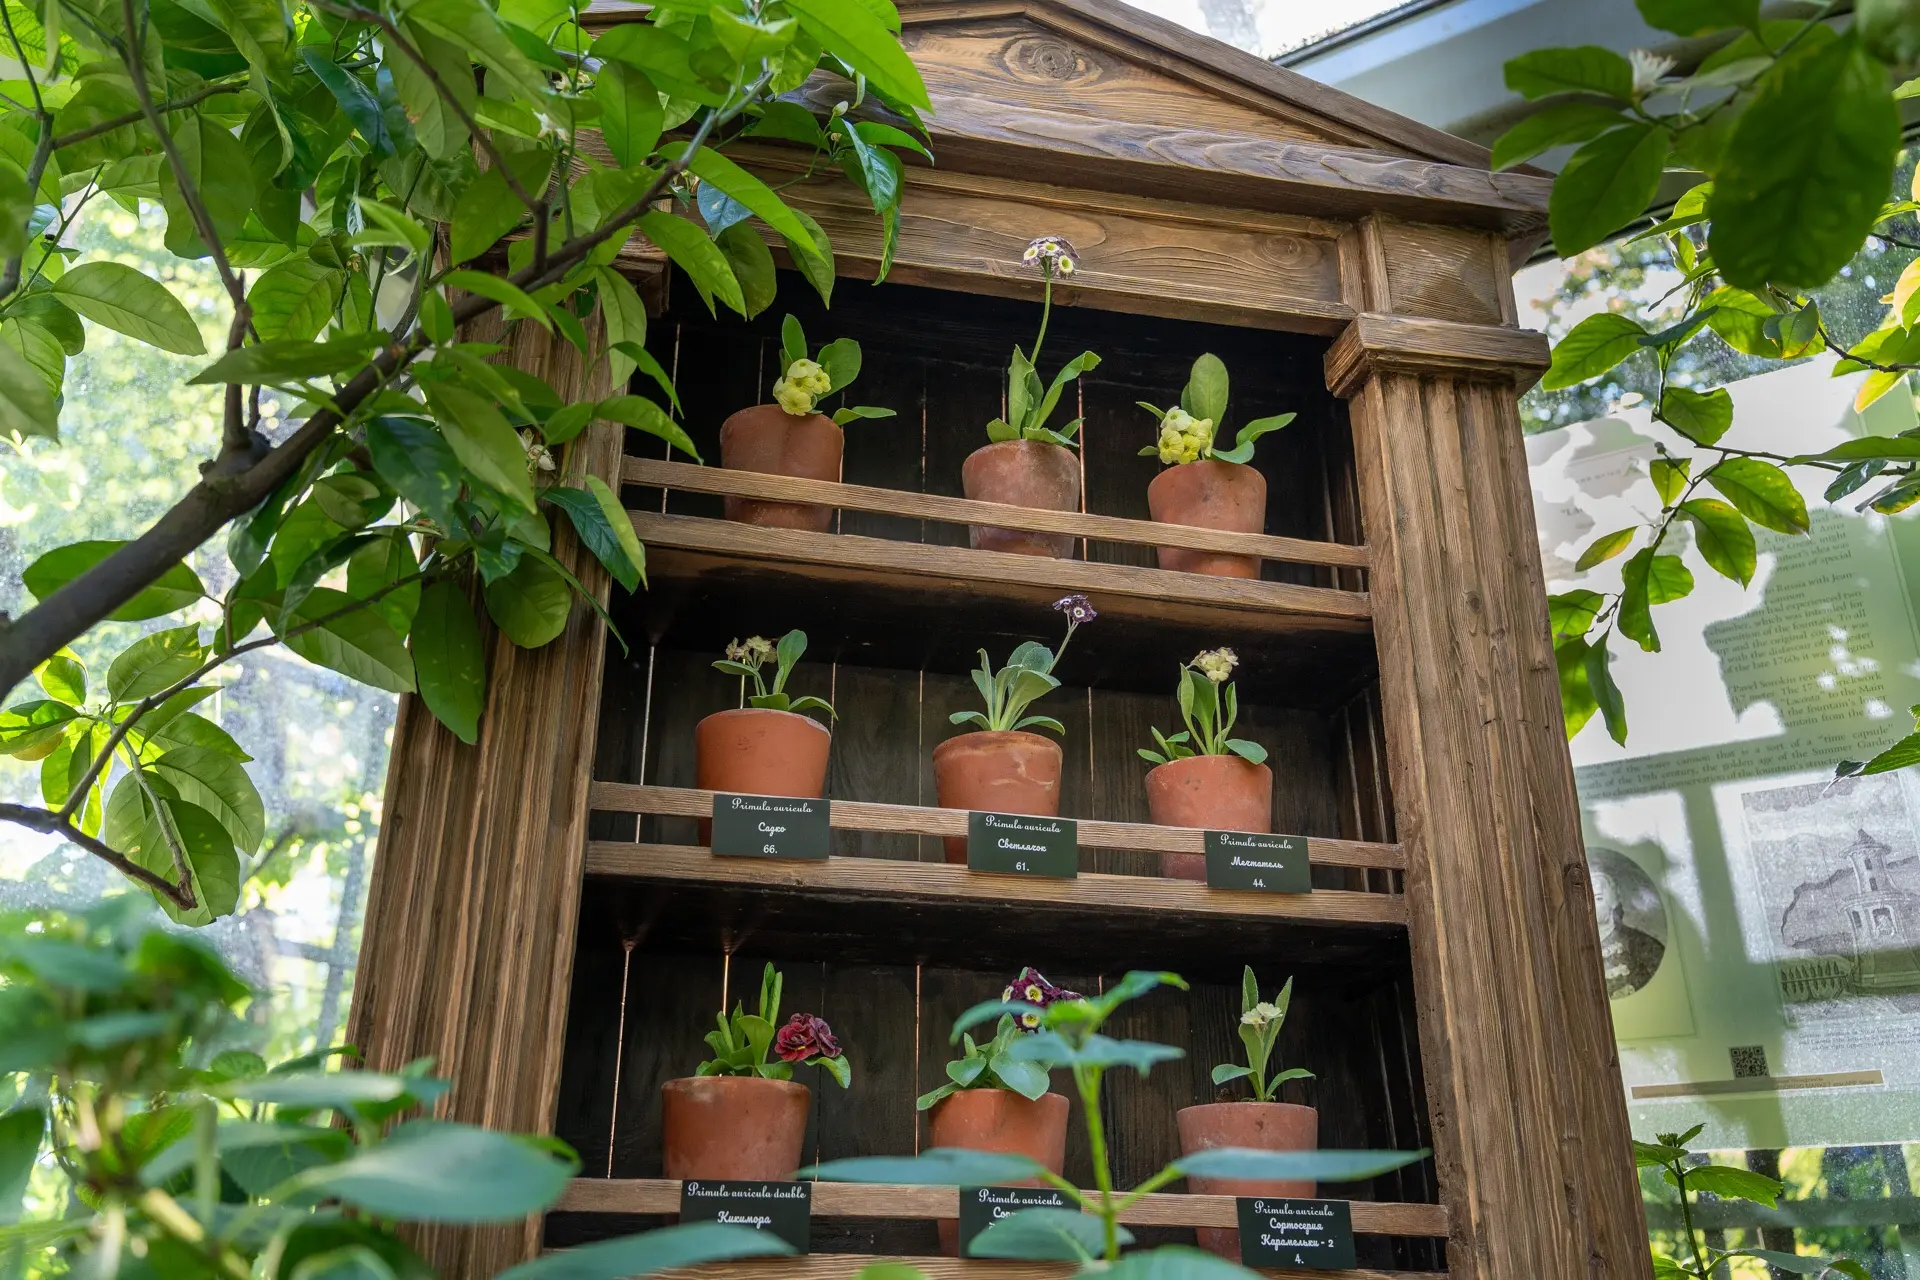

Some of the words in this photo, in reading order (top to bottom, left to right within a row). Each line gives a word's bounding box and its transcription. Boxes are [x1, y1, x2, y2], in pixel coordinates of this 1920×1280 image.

[1808, 558, 1818, 566] of
[1820, 549, 1853, 565] special
[1776, 582, 1807, 593] Russia
[1808, 574, 1830, 586] with
[1766, 602, 1783, 614] had
[1786, 591, 1842, 611] experienced
[1843, 590, 1863, 600] two
[1785, 612, 1803, 621] was
[1849, 599, 1864, 610] for
[1710, 630, 1760, 646] omposition
[1763, 627, 1772, 636] of
[1775, 624, 1790, 634] the
[1839, 612, 1853, 621] To
[1854, 607, 1867, 619] all
[1732, 641, 1749, 653] and
[1752, 638, 1768, 649] the
[1770, 630, 1808, 647] original
[1851, 621, 1869, 630] was
[1727, 651, 1748, 664] with
[1751, 649, 1766, 659] the
[1814, 639, 1824, 648] of
[1735, 662, 1751, 672] the
[1752, 660, 1770, 670] late
[1802, 652, 1810, 661] it
[1812, 650, 1830, 659] was
[1732, 681, 1758, 694] Pavel
[1759, 676, 1796, 688] Sorokin
[1780, 685, 1800, 696] The
[1827, 691, 1839, 699] to
[1840, 686, 1857, 697] the
[1859, 683, 1885, 694] Main
[1787, 706, 1804, 717] the
[1807, 698, 1857, 714] fountain's
[1779, 717, 1818, 729] ountain
[1821, 711, 1846, 723] from
[1848, 708, 1864, 719] the
[1715, 748, 1735, 760] that
[1766, 742, 1785, 752] sort
[1790, 737, 1801, 748] of
[1662, 768, 1699, 780] century,
[1702, 762, 1718, 772] the
[1721, 757, 1754, 771] golden
[1758, 755, 1773, 766] age
[1777, 752, 1788, 761] of
[1791, 748, 1808, 759] the
[1811, 743, 1853, 756] Summer
[731, 797, 772, 811] Primula
[773, 802, 813, 813] auricula
[985, 814, 1023, 830] Primula
[1024, 822, 1061, 833] auricula
[763, 844, 778, 854] 66.
[997, 838, 1047, 852] Светлячок
[1220, 833, 1257, 848] Primula
[1257, 839, 1293, 850] auricula
[1015, 861, 1030, 872] 61.
[1230, 856, 1284, 869] Мечтатель
[1253, 878, 1266, 888] 44.
[688, 1181, 730, 1197] Primula
[731, 1185, 772, 1198] auricula
[773, 1185, 807, 1199] double
[978, 1188, 1021, 1205] Primula
[1022, 1193, 1063, 1206] auricula
[1254, 1200, 1294, 1215] Primula
[1295, 1204, 1335, 1217] auricula
[717, 1210, 772, 1229] Кикимора
[1269, 1217, 1324, 1235] Сортосерия
[1260, 1234, 1320, 1252] Карамельки
[1327, 1239, 1335, 1248] 2
[1294, 1253, 1305, 1264] 4.
